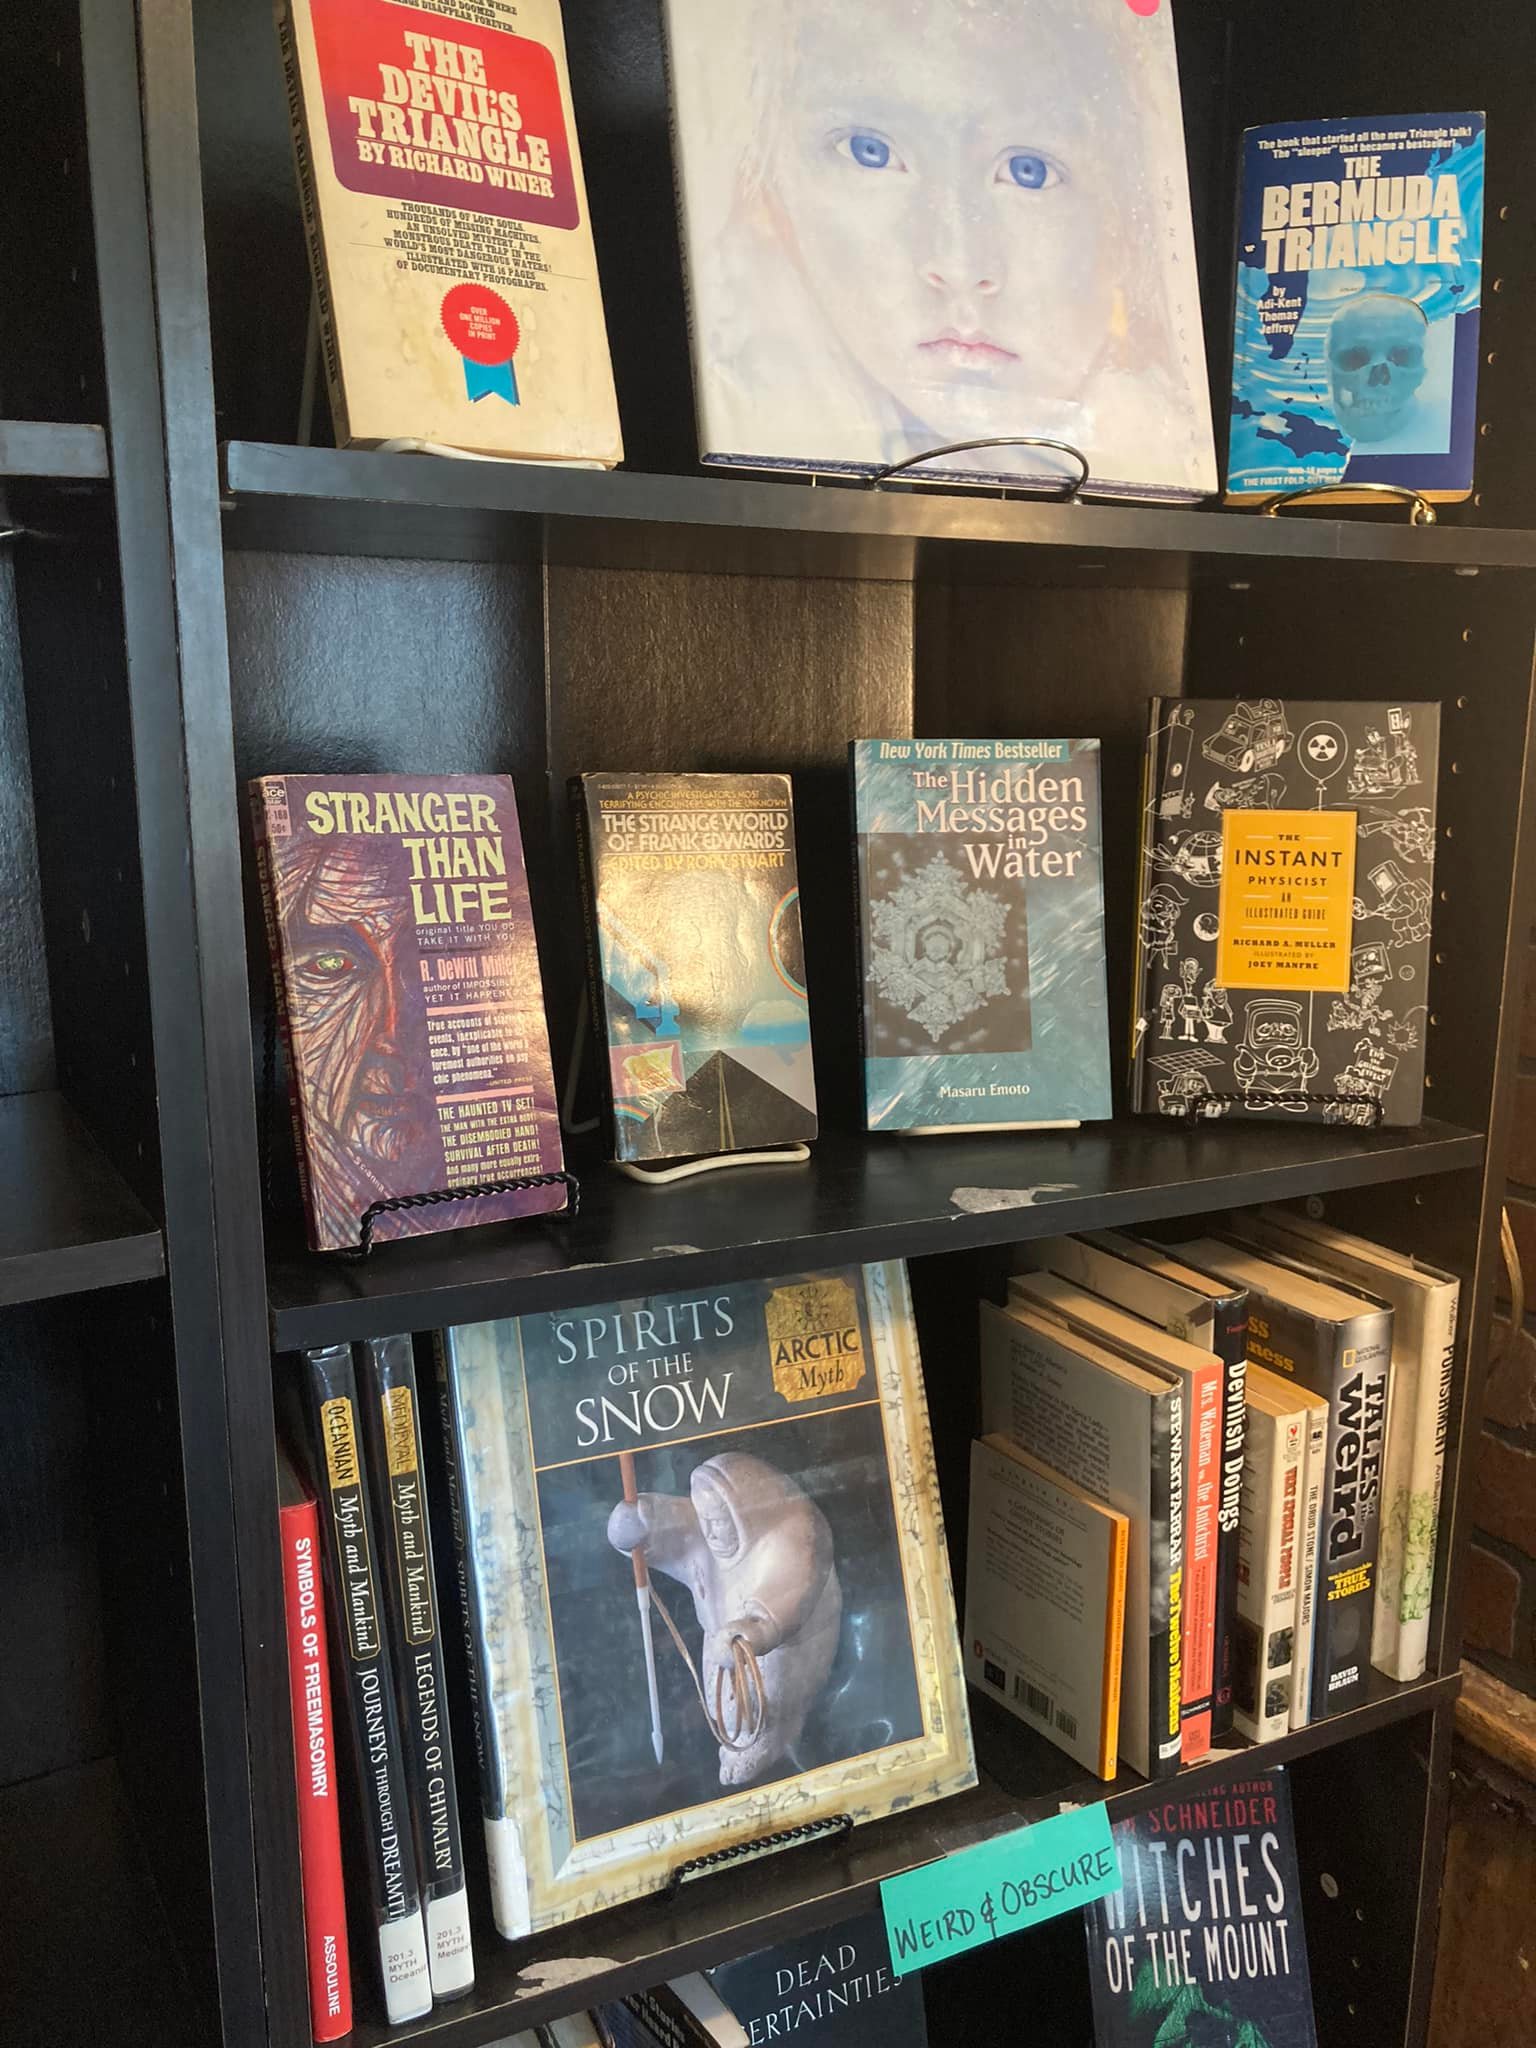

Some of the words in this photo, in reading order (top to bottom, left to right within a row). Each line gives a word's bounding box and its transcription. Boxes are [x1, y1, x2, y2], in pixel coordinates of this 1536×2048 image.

[403, 30, 487, 86] THE
[378, 63, 522, 131] DEVIL'S
[348, 96, 552, 175] TRIANGLE
[1258, 139, 1275, 150] The
[1276, 137, 1300, 149] book
[1302, 135, 1320, 146] that
[1322, 132, 1355, 145] started
[1357, 132, 1369, 142] all
[1371, 131, 1386, 142] the
[1387, 131, 1407, 141] new
[1409, 128, 1448, 140] Triangle
[1450, 126, 1472, 138] talk!
[1273, 148, 1290, 159] The
[1340, 143, 1358, 154] that
[1360, 141, 1396, 152] became
[1406, 138, 1457, 149] bestseller!
[356, 139, 386, 165] BY
[390, 146, 484, 184] RICHARD
[485, 165, 555, 198] WINER
[1344, 156, 1382, 178] THE
[401, 202, 457, 219] THOUSANDS
[459, 211, 470, 221] OF
[473, 213, 494, 226] LOST
[1262, 175, 1461, 230] BERMUDA
[386, 209, 438, 224] HUNDREDS
[454, 220, 491, 235] MISSING
[406, 222, 419, 231] AN
[423, 225, 470, 239] UNSOLVED
[384, 238, 427, 251] WORLD'S
[430, 243, 454, 256] MOST
[457, 247, 510, 266] DANGEROUS
[513, 255, 552, 272] WATERS!
[393, 230, 450, 247] MONSTROUS
[453, 238, 483, 251] DEATH
[485, 243, 508, 257] TRAP
[524, 251, 541, 261] THE
[1261, 218, 1466, 274] TRIANGLE
[396, 260, 408, 269] OF
[412, 261, 481, 282] DOCUMENTARY
[407, 252, 468, 269] ILLUSTRATED
[471, 261, 495, 274] WITH
[508, 266, 536, 280] PAGES
[1257, 297, 1302, 309] Adi-Kent
[1273, 286, 1286, 297] by
[1258, 310, 1298, 321] Thomas
[879, 742, 912, 760] New
[914, 742, 948, 759] York
[951, 742, 992, 759] Times
[995, 742, 1063, 759] Bestseller
[262, 788, 285, 798] ace
[912, 770, 949, 790] The
[949, 768, 1085, 805] Hidden
[304, 791, 502, 835] STRANGER
[601, 814, 636, 834] THE
[638, 812, 722, 834] STRANGE
[723, 812, 789, 831] WORLD
[915, 799, 1088, 846] Messages
[402, 836, 507, 880] THAN
[607, 834, 635, 852] OF
[638, 833, 700, 851] FRANK
[702, 831, 785, 850] EDWARDS
[1007, 833, 1028, 850] in
[1235, 850, 1343, 867] INSTANT
[729, 852, 785, 869] STUART
[962, 842, 1082, 880] Water
[1248, 875, 1328, 886] PHYSICIST
[410, 881, 512, 925] LIFE
[1245, 908, 1299, 920] ILLUSTRATED
[1302, 909, 1326, 921] GUIDE
[418, 937, 444, 946] TAKE
[449, 935, 460, 944] IT
[464, 934, 490, 943] WITH
[455, 925, 475, 934] title
[1233, 939, 1280, 947] RICHARD
[1294, 940, 1336, 949] MULLER
[420, 960, 434, 981] R.
[437, 956, 479, 980] DeWitt
[1248, 961, 1272, 969] JOEY
[1276, 961, 1319, 970] MANFRE
[423, 982, 451, 993] author
[939, 1083, 986, 1098] Masaru
[989, 1082, 1031, 1096] Emoto
[437, 1107, 455, 1121] THE
[458, 1101, 498, 1119] HAUNTED
[502, 1100, 513, 1112] TV
[516, 1096, 535, 1111] SET!
[442, 1136, 457, 1148] THE
[460, 1129, 512, 1145] DISEMBODIED
[514, 1123, 539, 1137] HAND!
[444, 1147, 484, 1163] SURVIVAL
[486, 1143, 510, 1156] AFTER
[512, 1138, 540, 1152] DEATH!
[555, 1296, 734, 1365] SPIRITS
[774, 1328, 859, 1366] ARCTIC
[607, 1360, 639, 1387] OF
[646, 1351, 694, 1380] THE
[796, 1359, 845, 1395] Myth
[575, 1371, 734, 1448] SNOW
[1200, 1380, 1218, 1408] Mrs.
[1225, 1360, 1248, 1452] Devilish
[1434, 1345, 1456, 1456] PUNISHMENT
[326, 1404, 355, 1481] OCEANIAN
[389, 1391, 411, 1469] MEDIEVAL
[1169, 1397, 1183, 1490] STEWART
[1198, 1411, 1217, 1467] Wakeman
[1358, 1373, 1387, 1503] TALES
[1328, 1372, 1365, 1562] Weird
[391, 1480, 417, 1526] Myth
[1196, 1482, 1213, 1503] the
[1217, 1455, 1244, 1533] Doings
[1309, 1485, 1319, 1502] THE
[334, 1493, 359, 1539] Myth
[1168, 1490, 1183, 1567] FARRAR
[1193, 1504, 1214, 1561] Antichrist
[1307, 1504, 1317, 1529] DRUID
[345, 1542, 360, 1574] and
[402, 1529, 417, 1561] and
[1305, 1531, 1315, 1558] STONE
[295, 1537, 318, 1629] SYMBOLS
[1303, 1564, 1314, 1591] SIMON
[1327, 1578, 1371, 1601] STORIES
[1335, 1570, 1367, 1590] TRUE
[349, 1577, 375, 1653] Mankind
[405, 1563, 433, 1637] Mankind
[1301, 1593, 1312, 1626] MAJORS
[301, 1633, 320, 1657] OF
[1328, 1673, 1359, 1692] BRAUN
[1330, 1666, 1359, 1683] DAVID
[415, 1653, 440, 1741] LEGENDS
[1169, 1660, 1182, 1735] Maidens
[304, 1661, 329, 1798] FREEMASONRY
[355, 1667, 388, 1763] JOURNEYS
[424, 1744, 443, 1772] OF
[375, 1765, 396, 1834] THROUGH
[1148, 1796, 1279, 1834] SCHNEIDER
[427, 1775, 454, 1871] CHIVALRY
[379, 1830, 408, 1921] DREAMTI
[893, 1907, 976, 1960] WEIRD
[980, 1892, 998, 1938] &
[1001, 1846, 1113, 1916] OBSCURE
[775, 1943, 857, 1998] DEAD
[1105, 1935, 1136, 1993] OF
[1146, 1928, 1197, 1989] THE
[1203, 1919, 1291, 1983] MOUNT
[323, 1934, 341, 2017] ASSOULINE
[746, 1966, 904, 2046] ERTAINTIE
